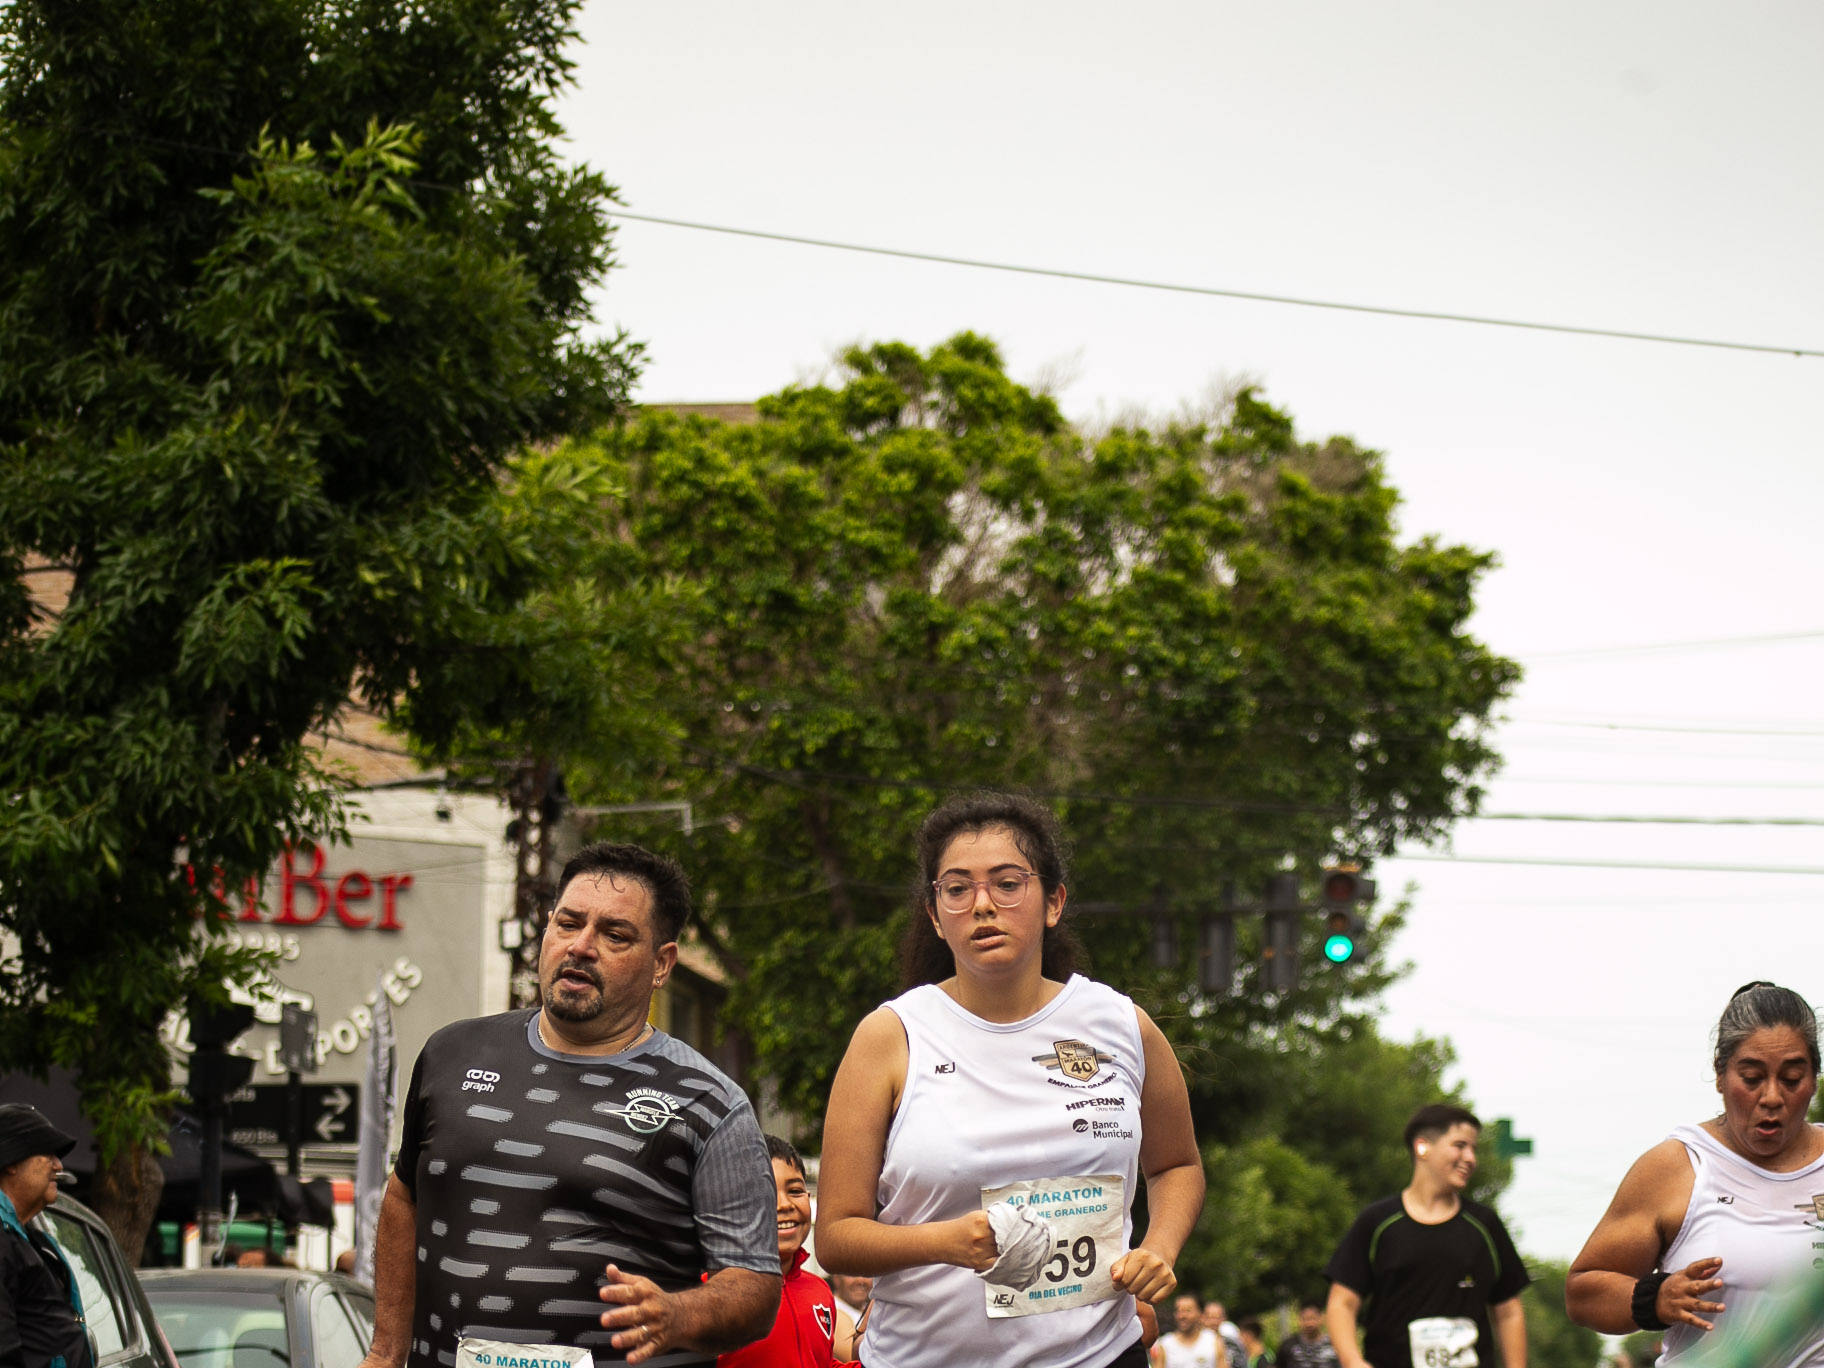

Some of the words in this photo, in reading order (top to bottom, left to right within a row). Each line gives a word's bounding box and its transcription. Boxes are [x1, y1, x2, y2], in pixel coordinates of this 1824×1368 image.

[935, 1061, 955, 1074] NEJ
[1071, 1061, 1093, 1074] 40
[461, 1080, 495, 1093] graph
[625, 1088, 662, 1100] RUNNING
[1092, 1120, 1119, 1129] Banco
[1093, 1129, 1133, 1140] Municipal
[1029, 1187, 1103, 1205] MARATON
[1054, 1204, 1108, 1217] GRANEROS
[1045, 1236, 1097, 1282] 59
[1029, 1290, 1042, 1300] DIA
[1043, 1288, 1056, 1298] DEL
[1058, 1284, 1083, 1295] VECINO
[993, 1294, 1015, 1305] NEJ
[475, 1354, 491, 1365] 40
